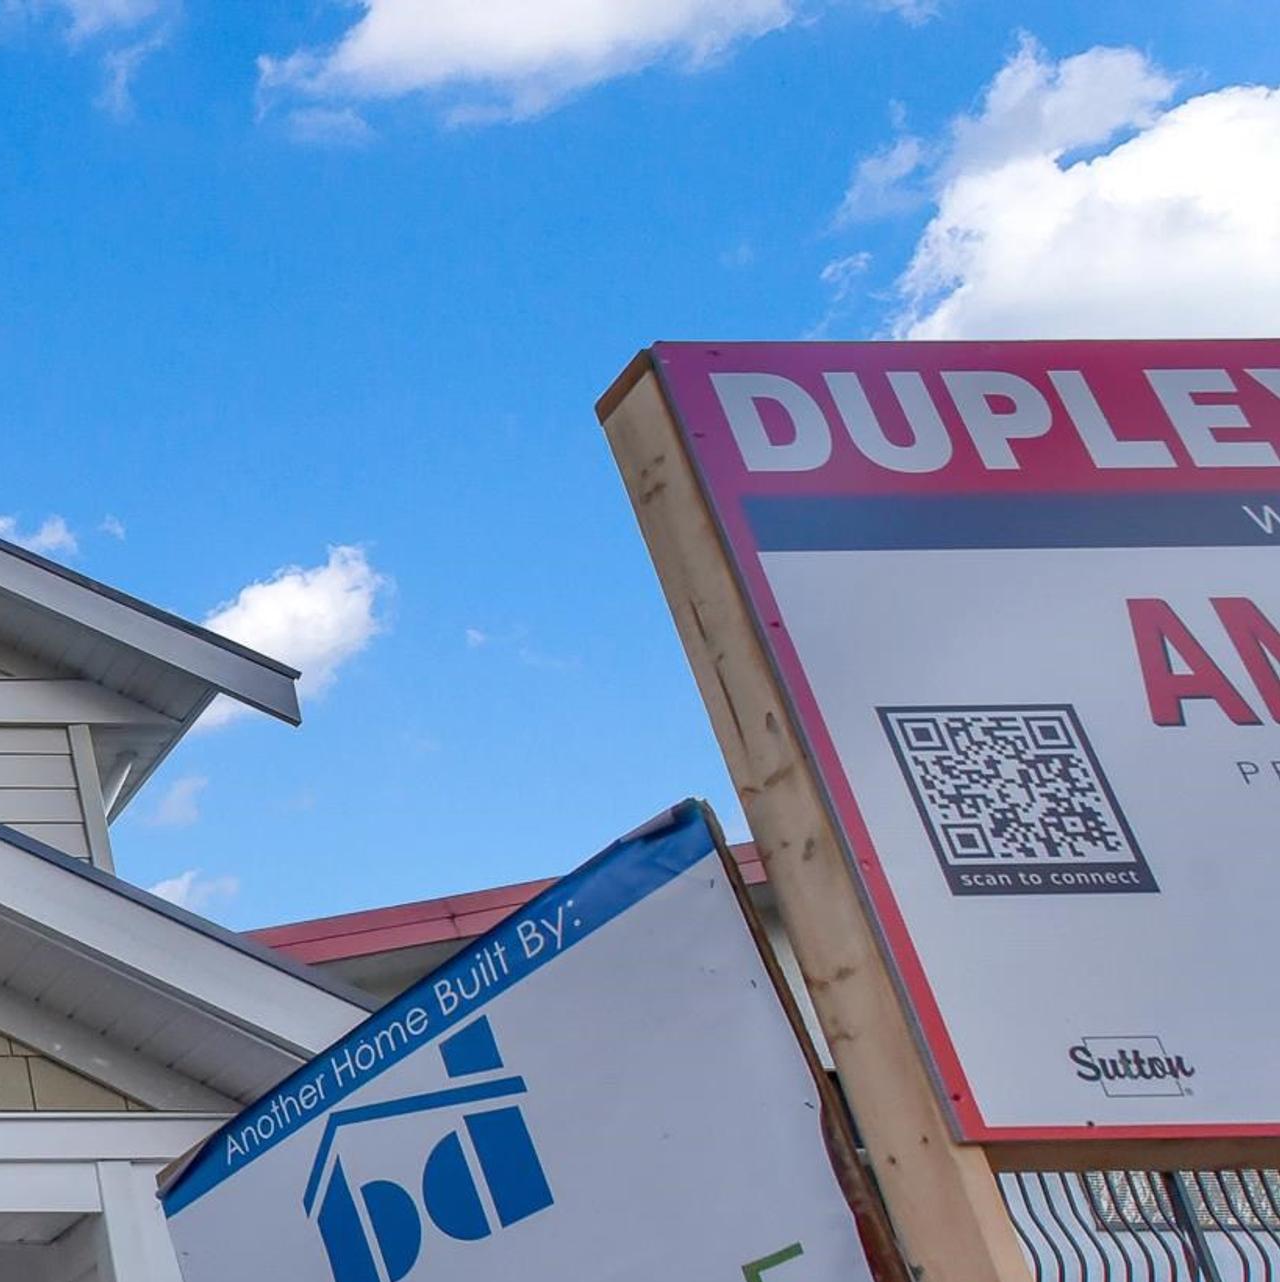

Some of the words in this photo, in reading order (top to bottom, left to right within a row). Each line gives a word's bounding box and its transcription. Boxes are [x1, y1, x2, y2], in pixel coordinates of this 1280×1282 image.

[960, 872, 1012, 887] scan
[1018, 871, 1042, 886] to
[1050, 869, 1140, 886] connect
[225, 1073, 327, 1166] Another
[332, 1005, 429, 1087] Home
[433, 944, 510, 1016] Built
[515, 899, 583, 959] By:
[1069, 1045, 1195, 1082] Sutton
